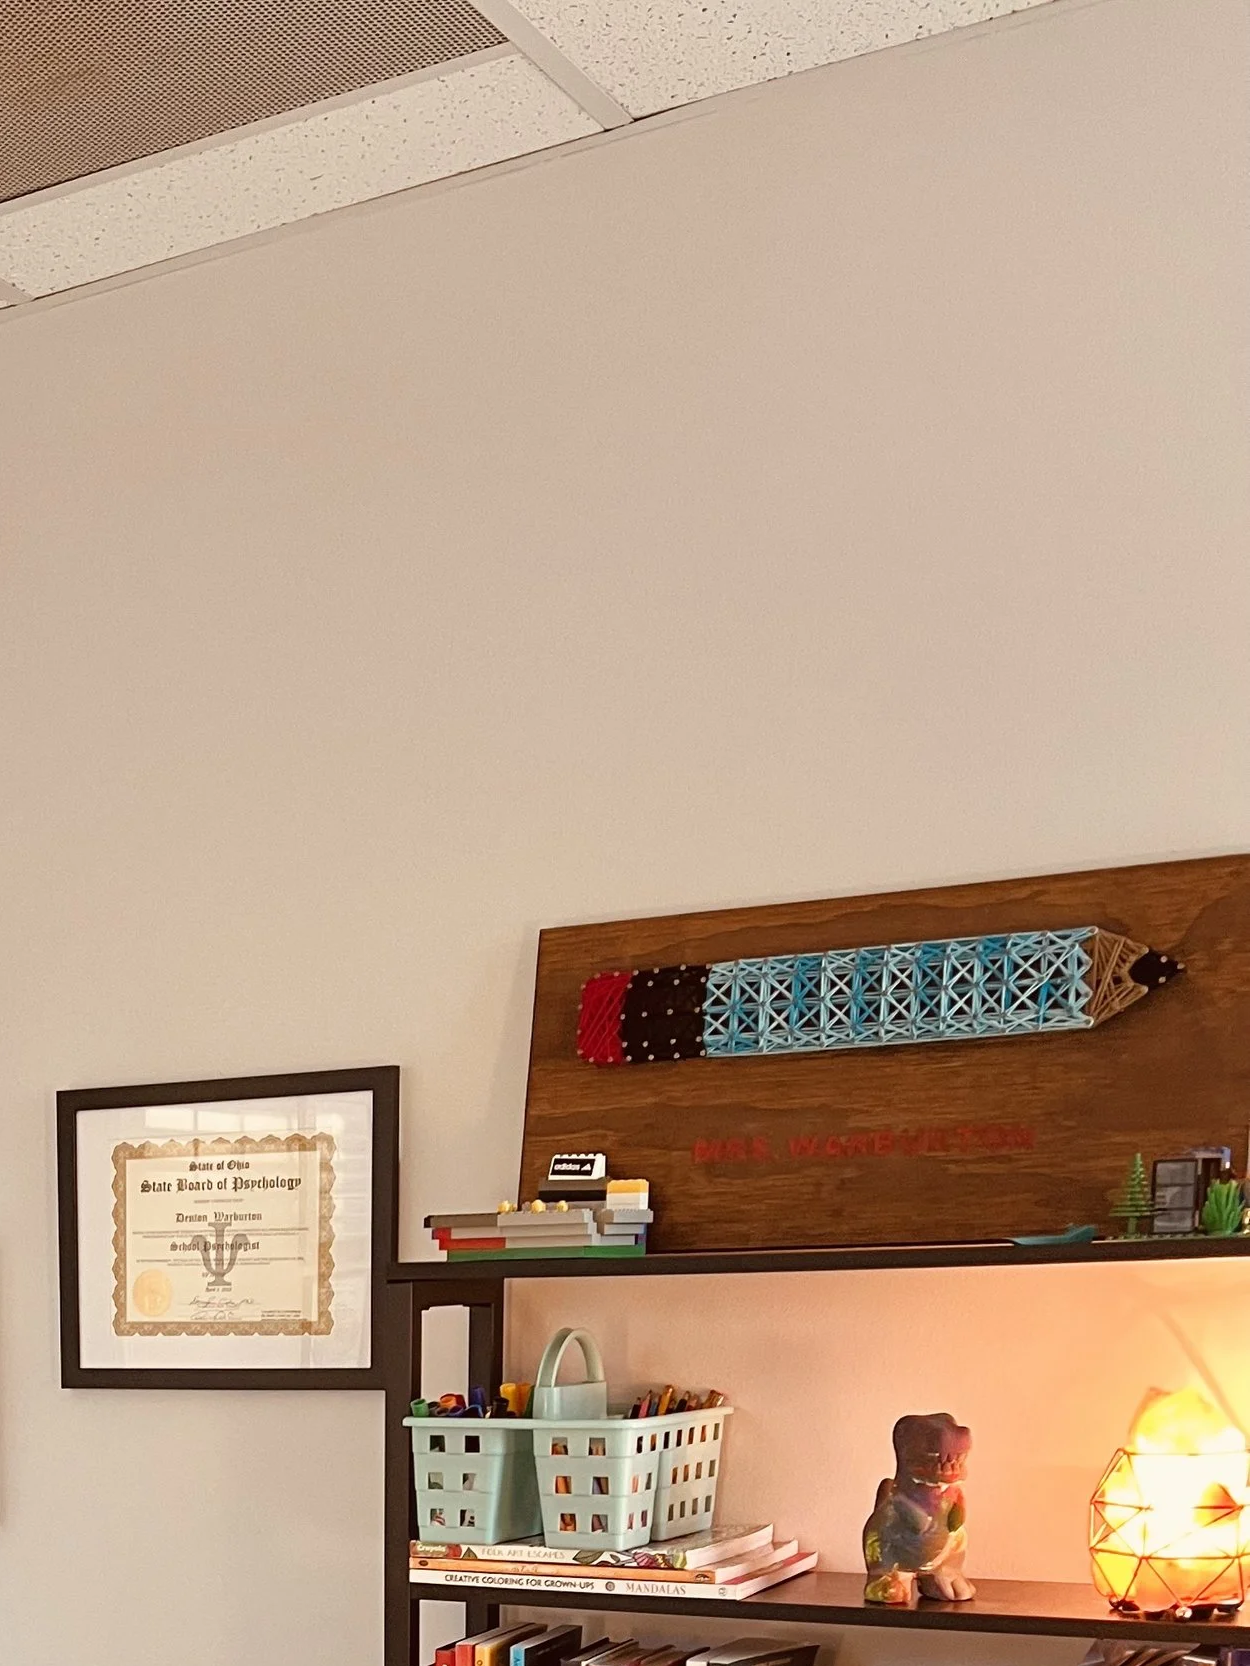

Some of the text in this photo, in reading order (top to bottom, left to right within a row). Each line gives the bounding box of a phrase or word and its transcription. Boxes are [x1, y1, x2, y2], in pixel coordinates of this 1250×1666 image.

[188, 1159, 250, 1172] State of Ohio
[554, 1163, 580, 1171] adidas
[140, 1175, 302, 1194] State Board of Psychology
[213, 1211, 262, 1223] Warburton
[169, 1240, 260, 1252] School Psychologist
[416, 1543, 447, 1555] Crayola
[481, 1547, 566, 1560] FOLK ART ESCAPES
[444, 1573, 687, 1596] CREATIVE COLORING FOR GROWN-UPS MANDALAS
